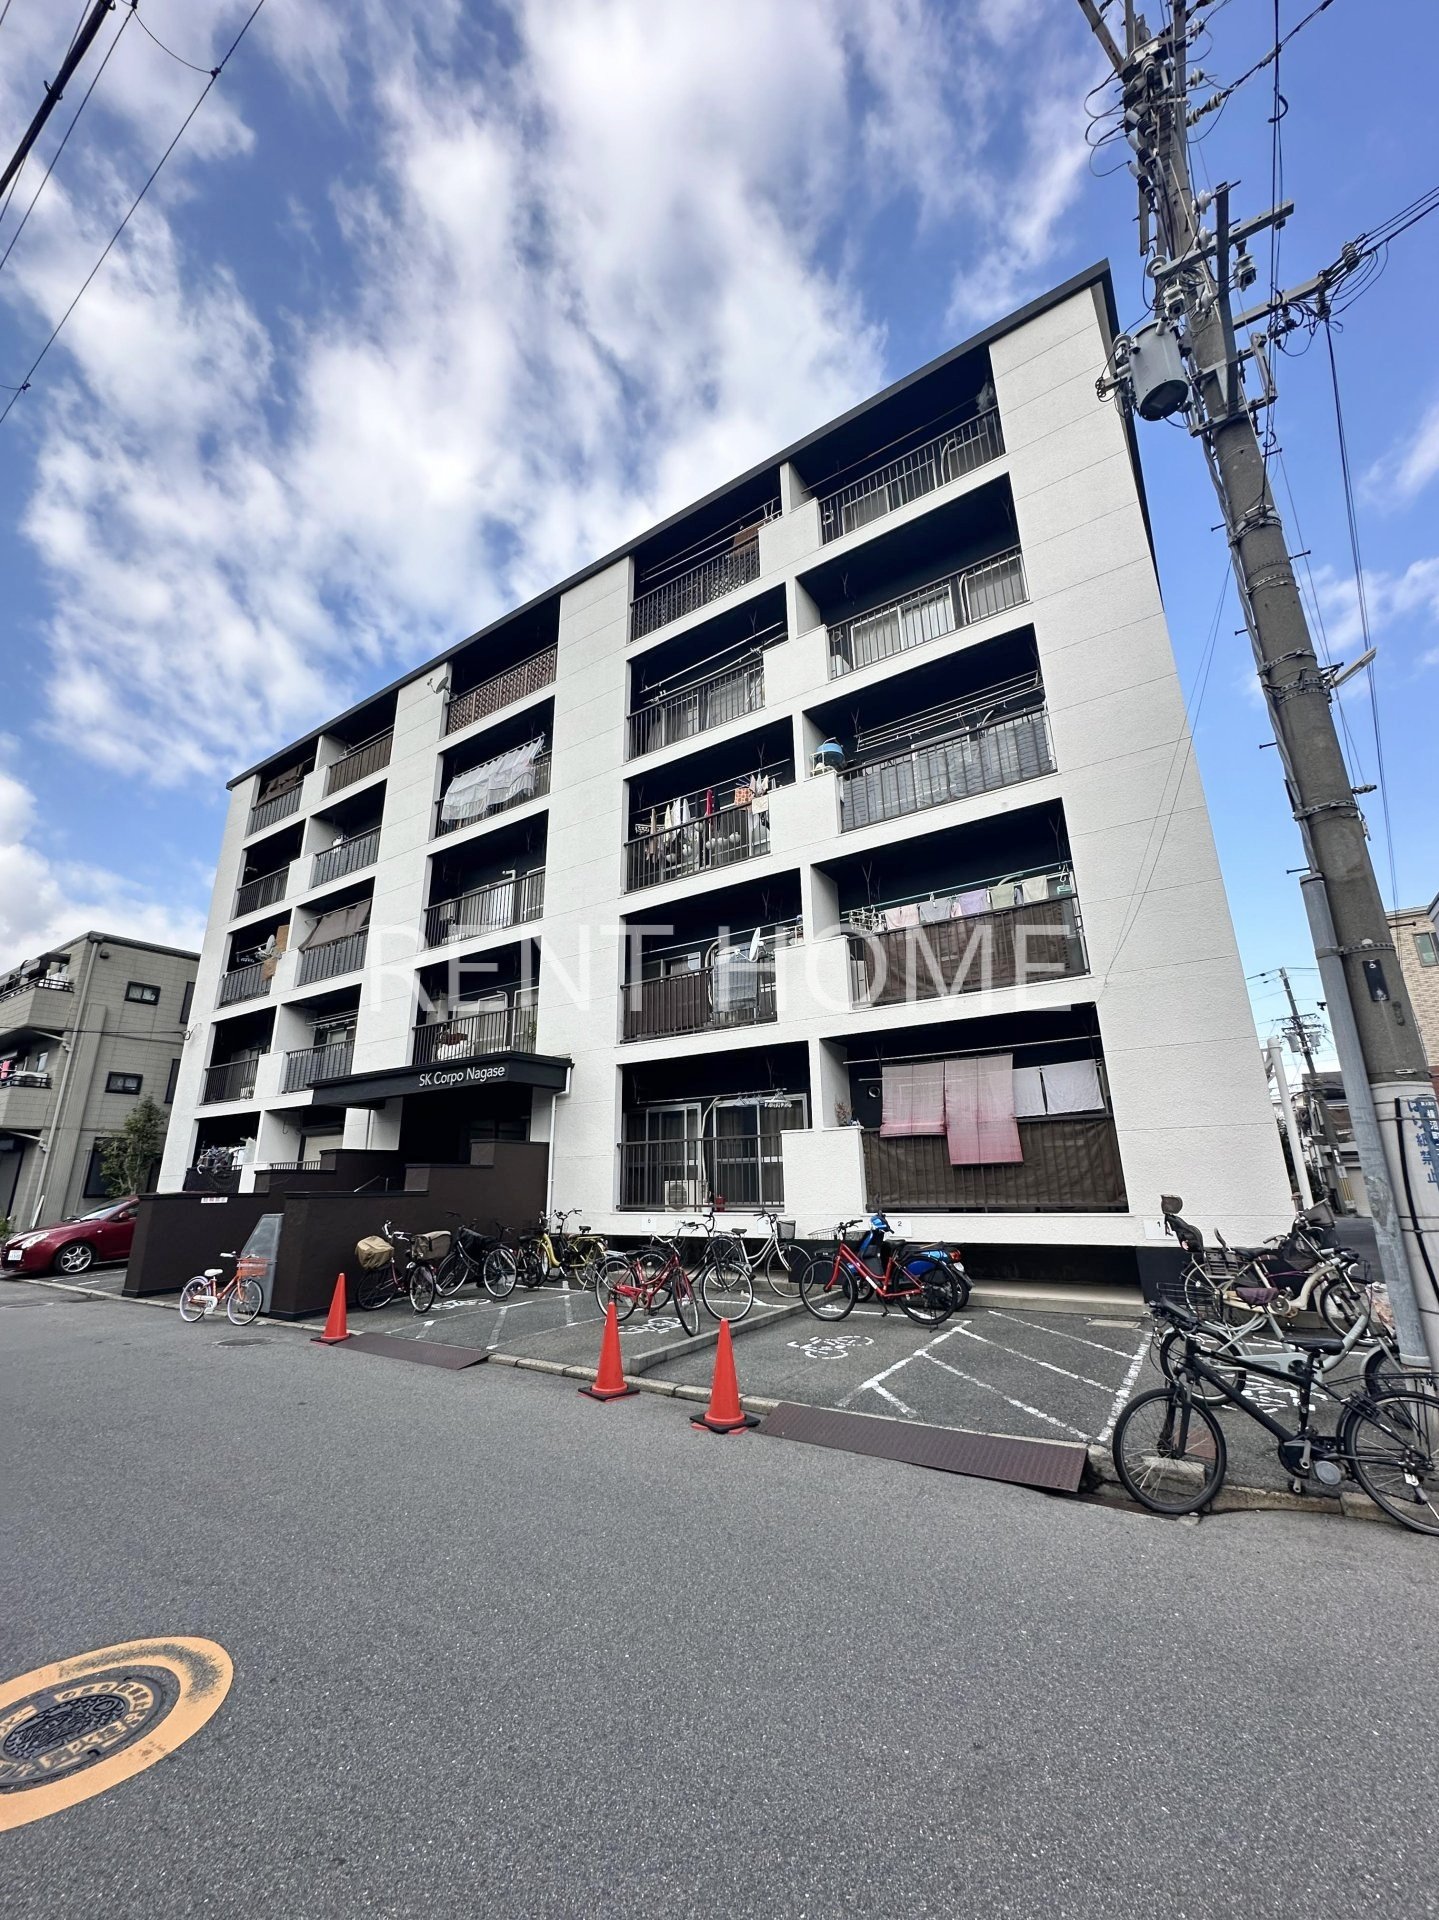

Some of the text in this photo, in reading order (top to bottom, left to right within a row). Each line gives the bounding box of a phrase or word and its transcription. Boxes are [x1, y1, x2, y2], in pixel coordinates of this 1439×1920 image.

[419, 1066, 506, 1087] SK Corpo Nagase
